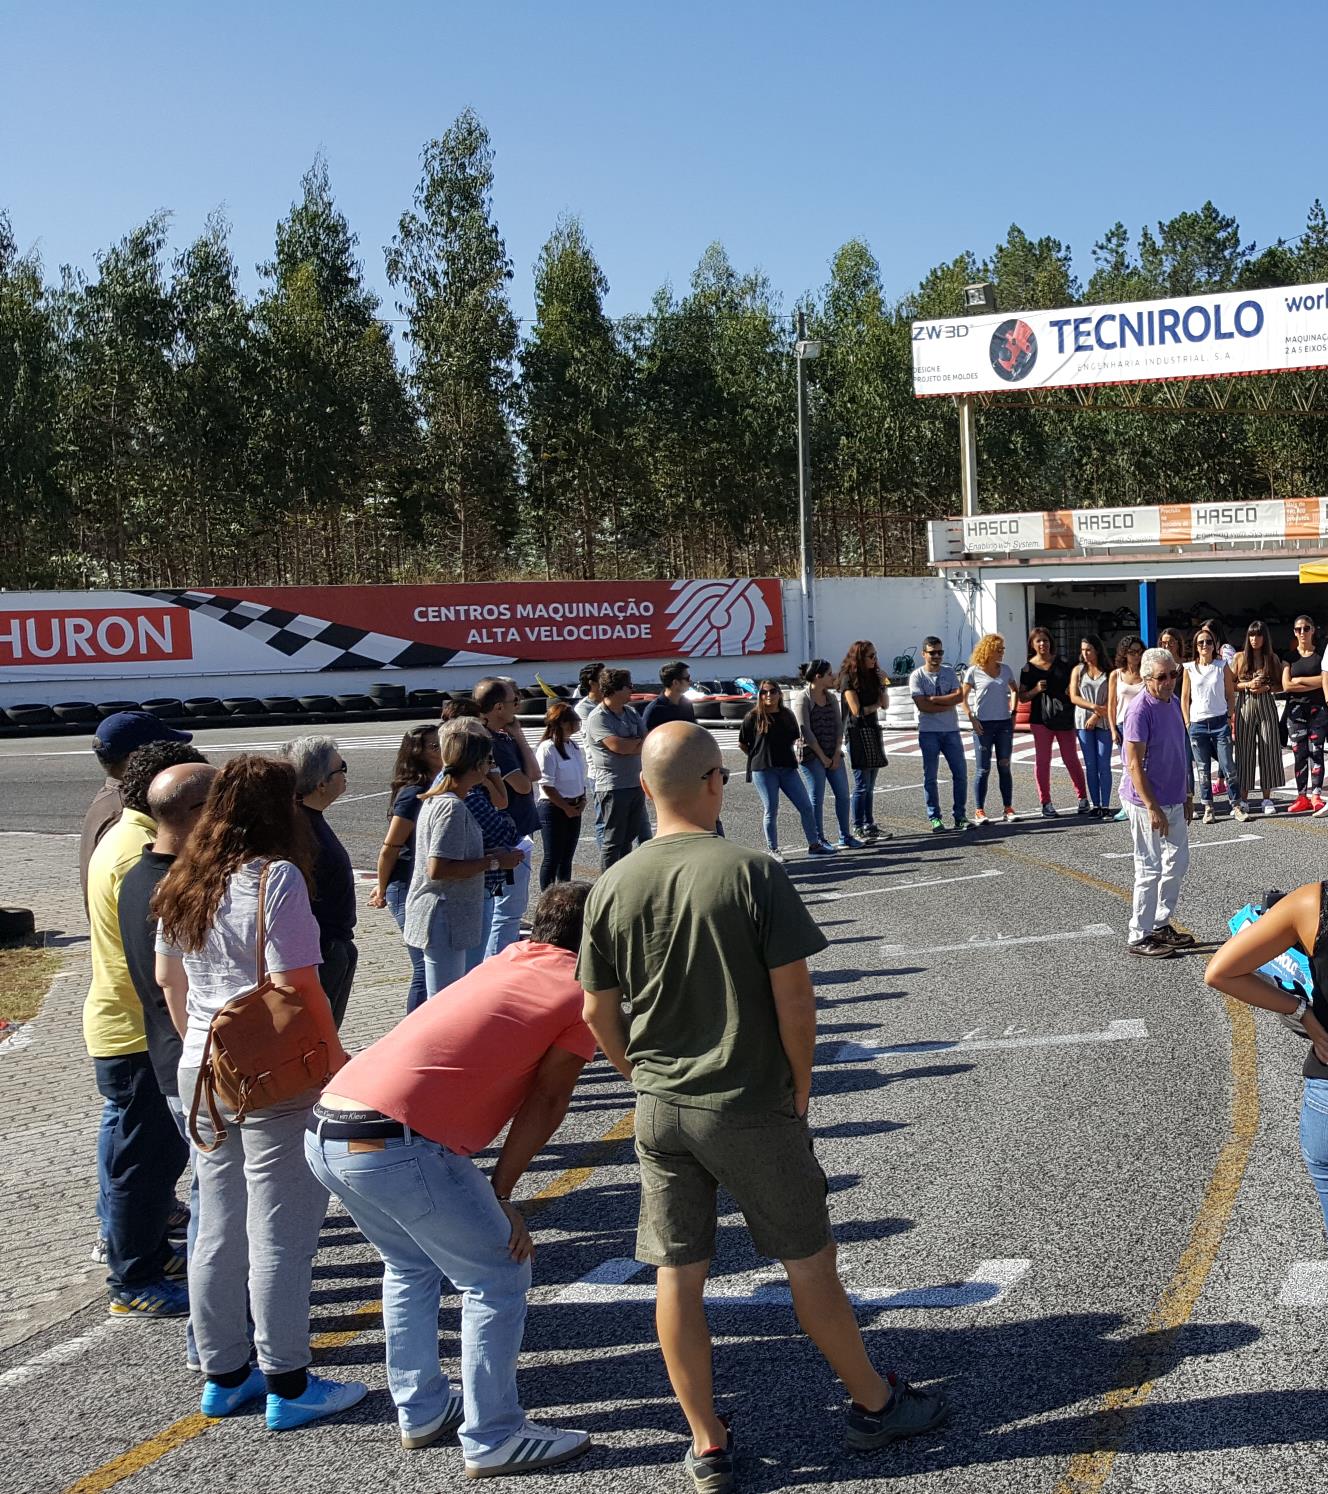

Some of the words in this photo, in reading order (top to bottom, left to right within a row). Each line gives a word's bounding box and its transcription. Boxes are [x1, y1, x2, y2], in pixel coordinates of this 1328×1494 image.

[912, 324, 969, 341] ZW3D
[1049, 299, 1265, 354] TECNIROLO
[1285, 347, 1290, 355] 2
[1304, 344, 1327, 353] EIXOS
[1077, 358, 1140, 372] ENGENHARIA
[942, 374, 951, 382] DE
[952, 372, 979, 381] MOLDES
[1077, 513, 1134, 531] HASCO
[1196, 507, 1257, 525] HASCO
[967, 519, 1019, 537] HASCO
[968, 541, 997, 551] Enabling
[413, 603, 511, 622] CENTROS
[516, 598, 654, 621] MAQUINAÇÃO
[467, 627, 521, 644] ALTA
[525, 624, 652, 641] VELOCIDADE
[348, 1111, 367, 1120] Klein
